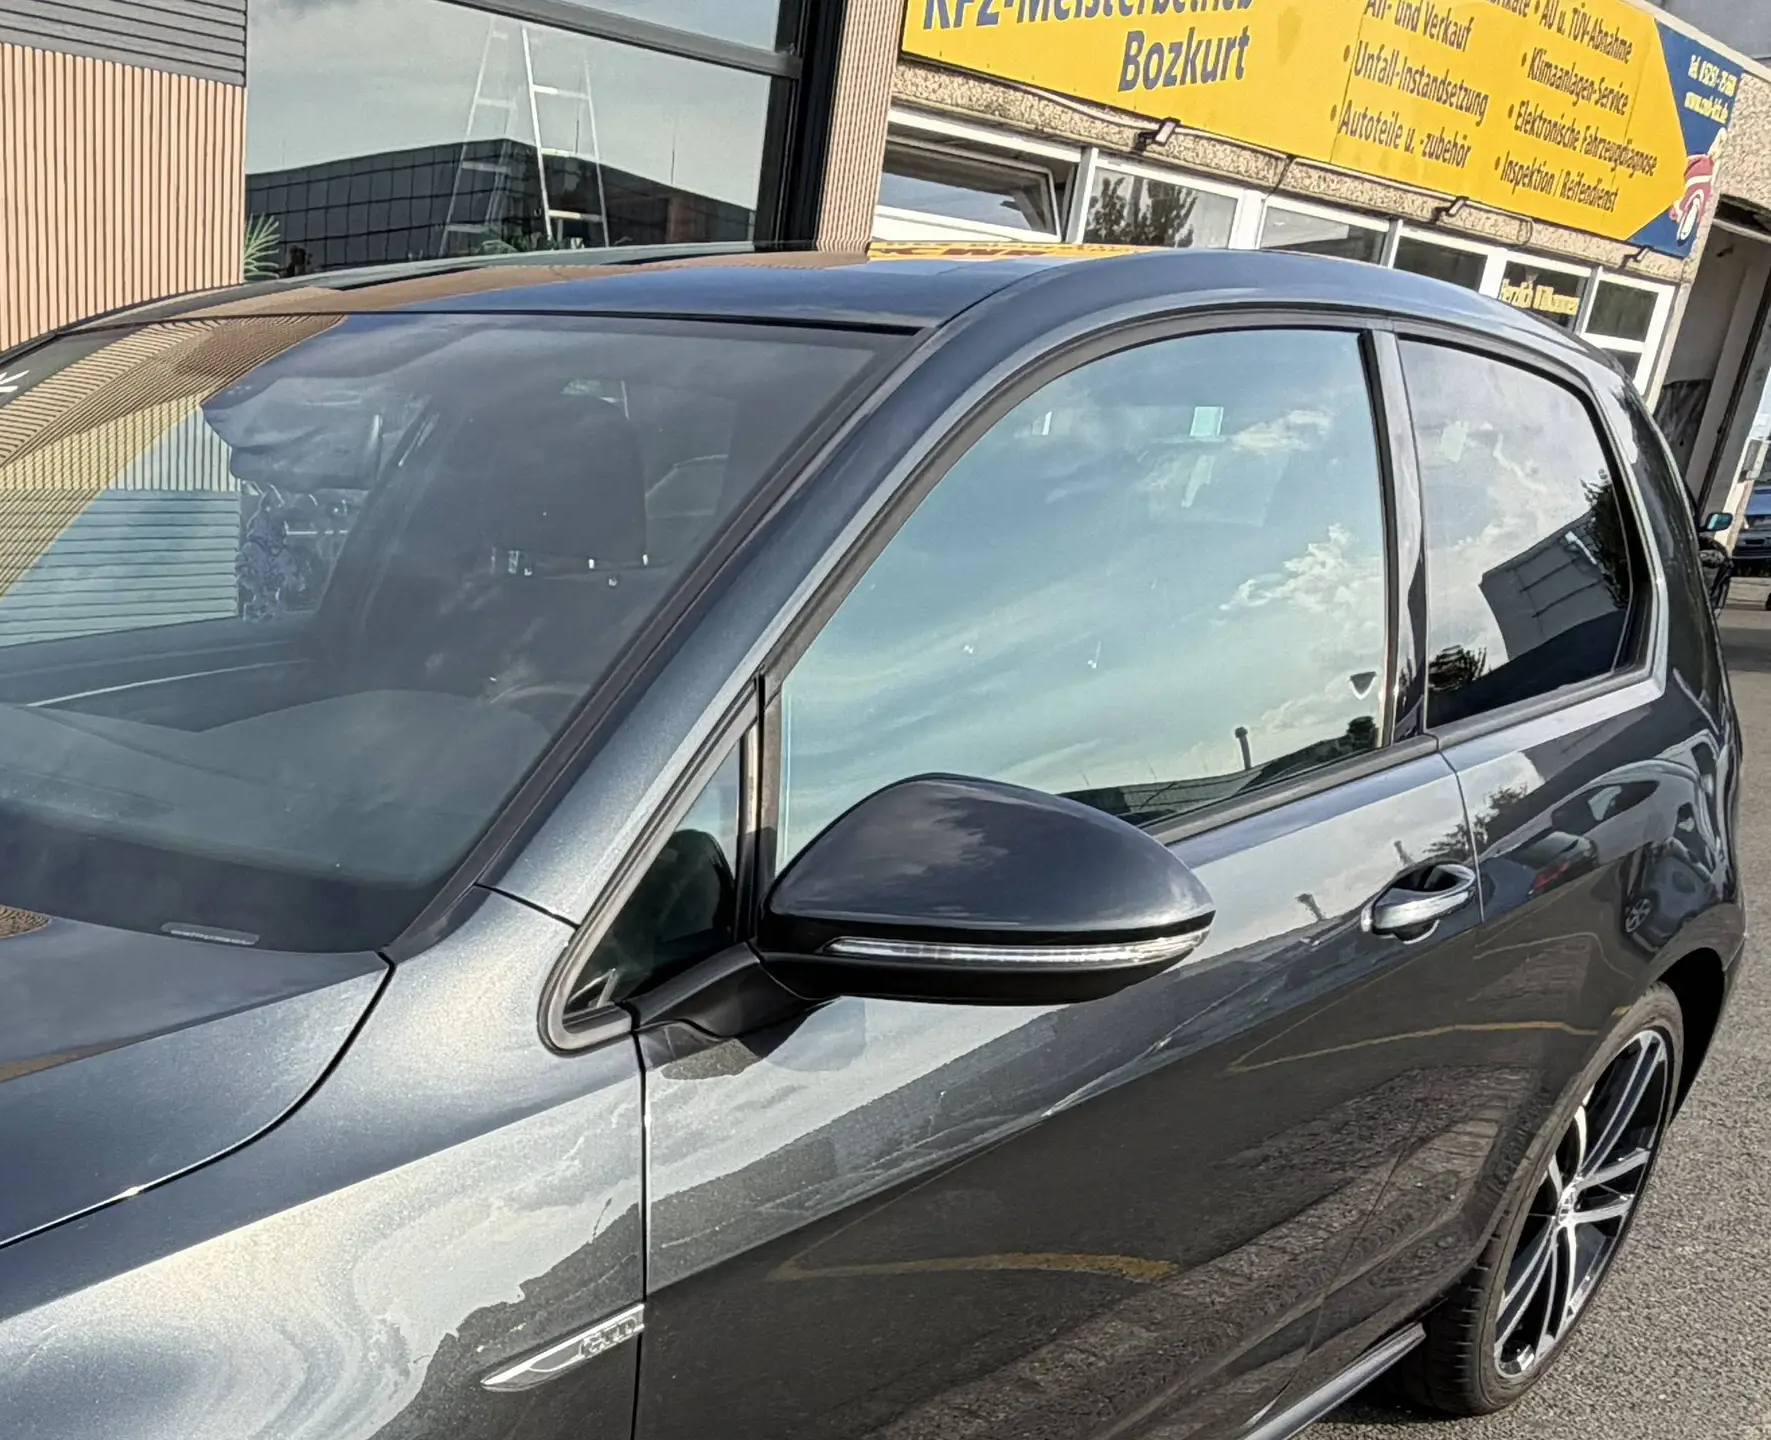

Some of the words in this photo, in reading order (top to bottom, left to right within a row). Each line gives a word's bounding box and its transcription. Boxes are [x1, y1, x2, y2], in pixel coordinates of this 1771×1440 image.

[1118, 25, 1250, 92] Bozkurt
[1394, 0, 1422, 33] und
[1422, 4, 1474, 52] Verkauf
[1568, 2, 1633, 64] TÜV-Abnahme
[1354, 40, 1490, 127] Unfall-Instandsetzung
[1527, 46, 1629, 117] Klimaanlagen-Service
[1337, 99, 1403, 150] Autoteile
[1403, 127, 1416, 154] u.
[1419, 126, 1472, 169] -zubehör
[1514, 99, 1580, 152] Elektronische
[1579, 125, 1658, 179] Fahrzeugdiagnose
[1500, 150, 1556, 195] Inspektion
[1559, 170, 1619, 213] Reifendienst
